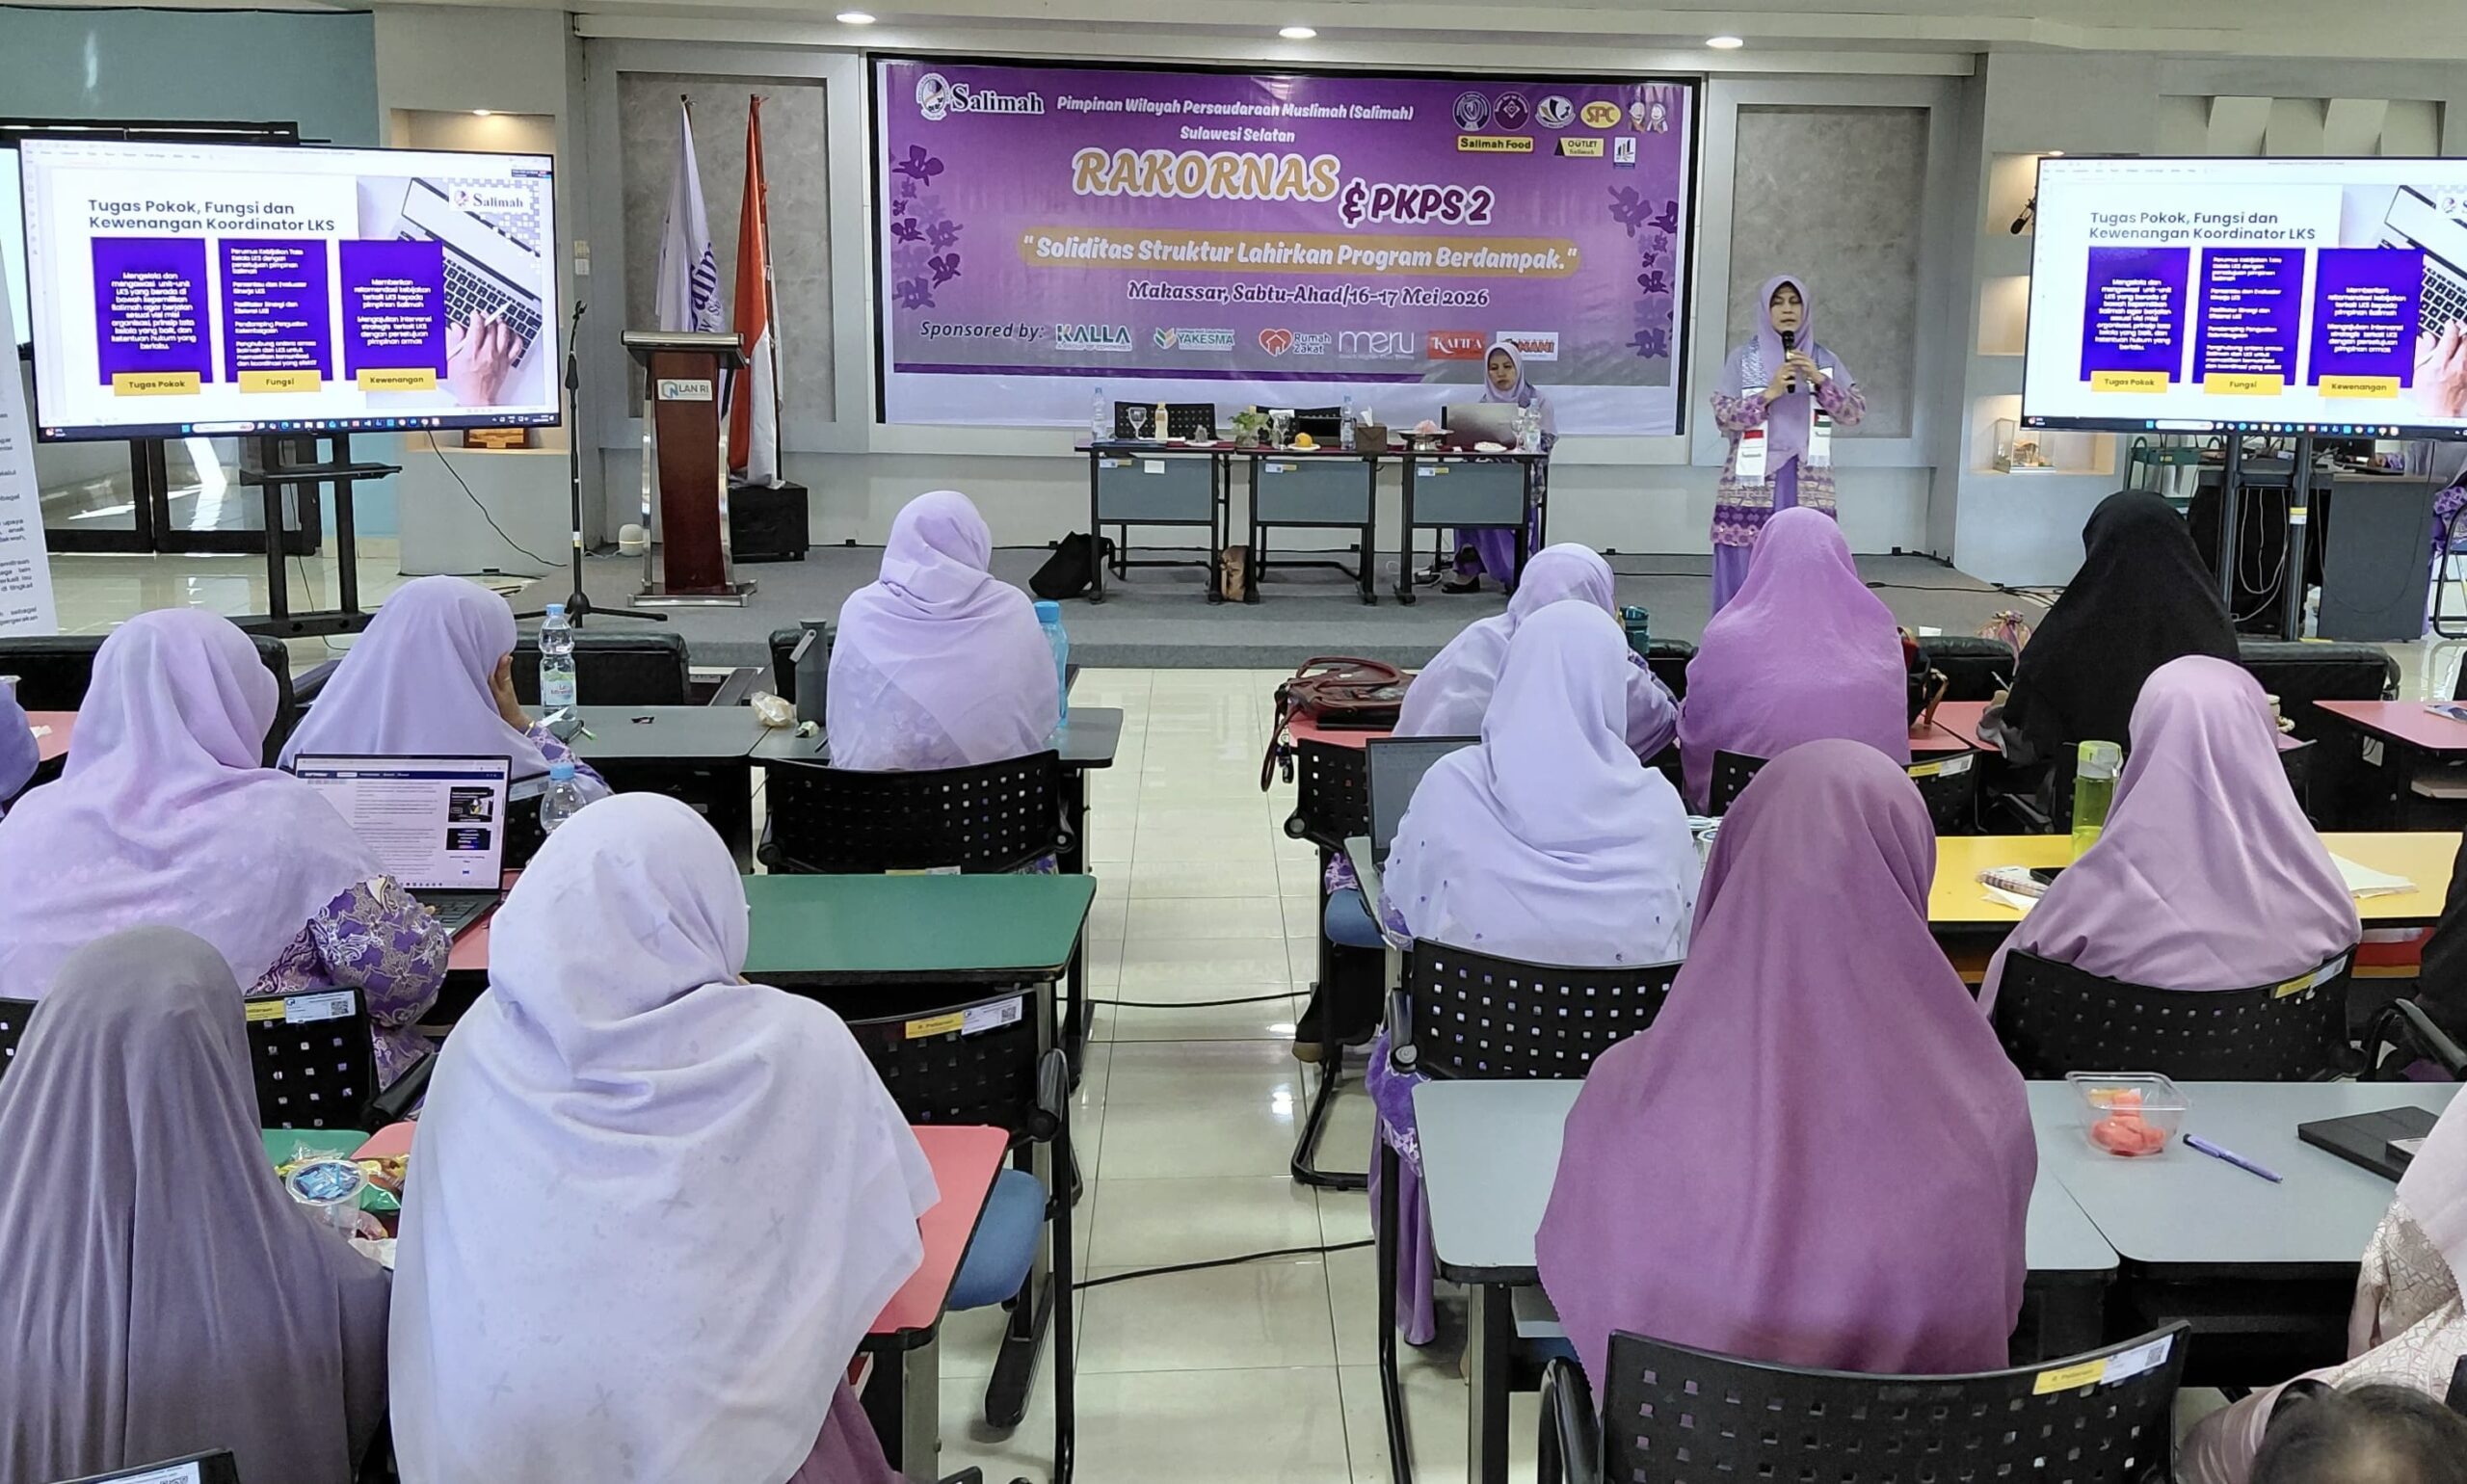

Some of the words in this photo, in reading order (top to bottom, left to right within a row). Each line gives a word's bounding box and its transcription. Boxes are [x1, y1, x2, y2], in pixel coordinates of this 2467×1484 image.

[951, 84, 1043, 113] Salimah
[1058, 96, 1124, 114] Pimpinan
[1126, 97, 1180, 117] Wilayah
[1182, 101, 1279, 118] Persaudaraan
[1282, 103, 1347, 119] Muslimah
[1349, 104, 1414, 121] (Salimah)
[1180, 126, 1242, 142] Sulawesi
[1244, 127, 1295, 143] Selatan
[1460, 138, 1503, 149] Salimah
[1505, 140, 1531, 149] Food
[1073, 148, 1340, 200] RAKORNAS
[89, 199, 141, 214] Tugas
[146, 200, 201, 214] Pokok,
[205, 200, 259, 217] Fungsi
[263, 201, 294, 214] dan
[473, 193, 523, 208] Salimah
[1340, 178, 1367, 227] &
[1369, 184, 1464, 223] PKPS
[1467, 185, 1495, 225] 2
[90, 216, 202, 232] Kewenangan
[206, 218, 305, 231] Koordinator
[308, 220, 334, 231] LKS
[2091, 212, 2136, 225] Tugas
[2140, 212, 2190, 225] Pokok,
[2194, 212, 2244, 226] Fungsi
[2248, 212, 2278, 224] dan
[2089, 227, 2188, 242] Kewenangan
[2193, 228, 2285, 240] Koordinator
[2289, 228, 2316, 240] LKS
[1138, 240, 1234, 262] Struktur
[1237, 242, 1333, 265] Lahirkan
[1337, 245, 1432, 271] Program
[1128, 280, 1230, 305] Makassar,
[1401, 288, 1441, 305] Mei
[1443, 289, 1489, 306] 2026
[920, 320, 1013, 341] Sponsored
[1019, 323, 1046, 342] by:
[1056, 324, 1131, 343] KALLA
[1177, 333, 1234, 344] YAKESMA
[1293, 332, 1331, 343] Rumah
[1293, 344, 1324, 354] Zakat
[1339, 331, 1415, 354] meru
[128, 381, 156, 389] Tugas
[266, 378, 295, 386] Fungsi
[370, 376, 424, 384] Kewenangan
[2105, 378, 2130, 386] Tugas
[2229, 380, 2257, 389] Fungsi
[2331, 383, 2387, 391] Kewenangan
[678, 384, 698, 393] LAN
[700, 384, 709, 393] RI
